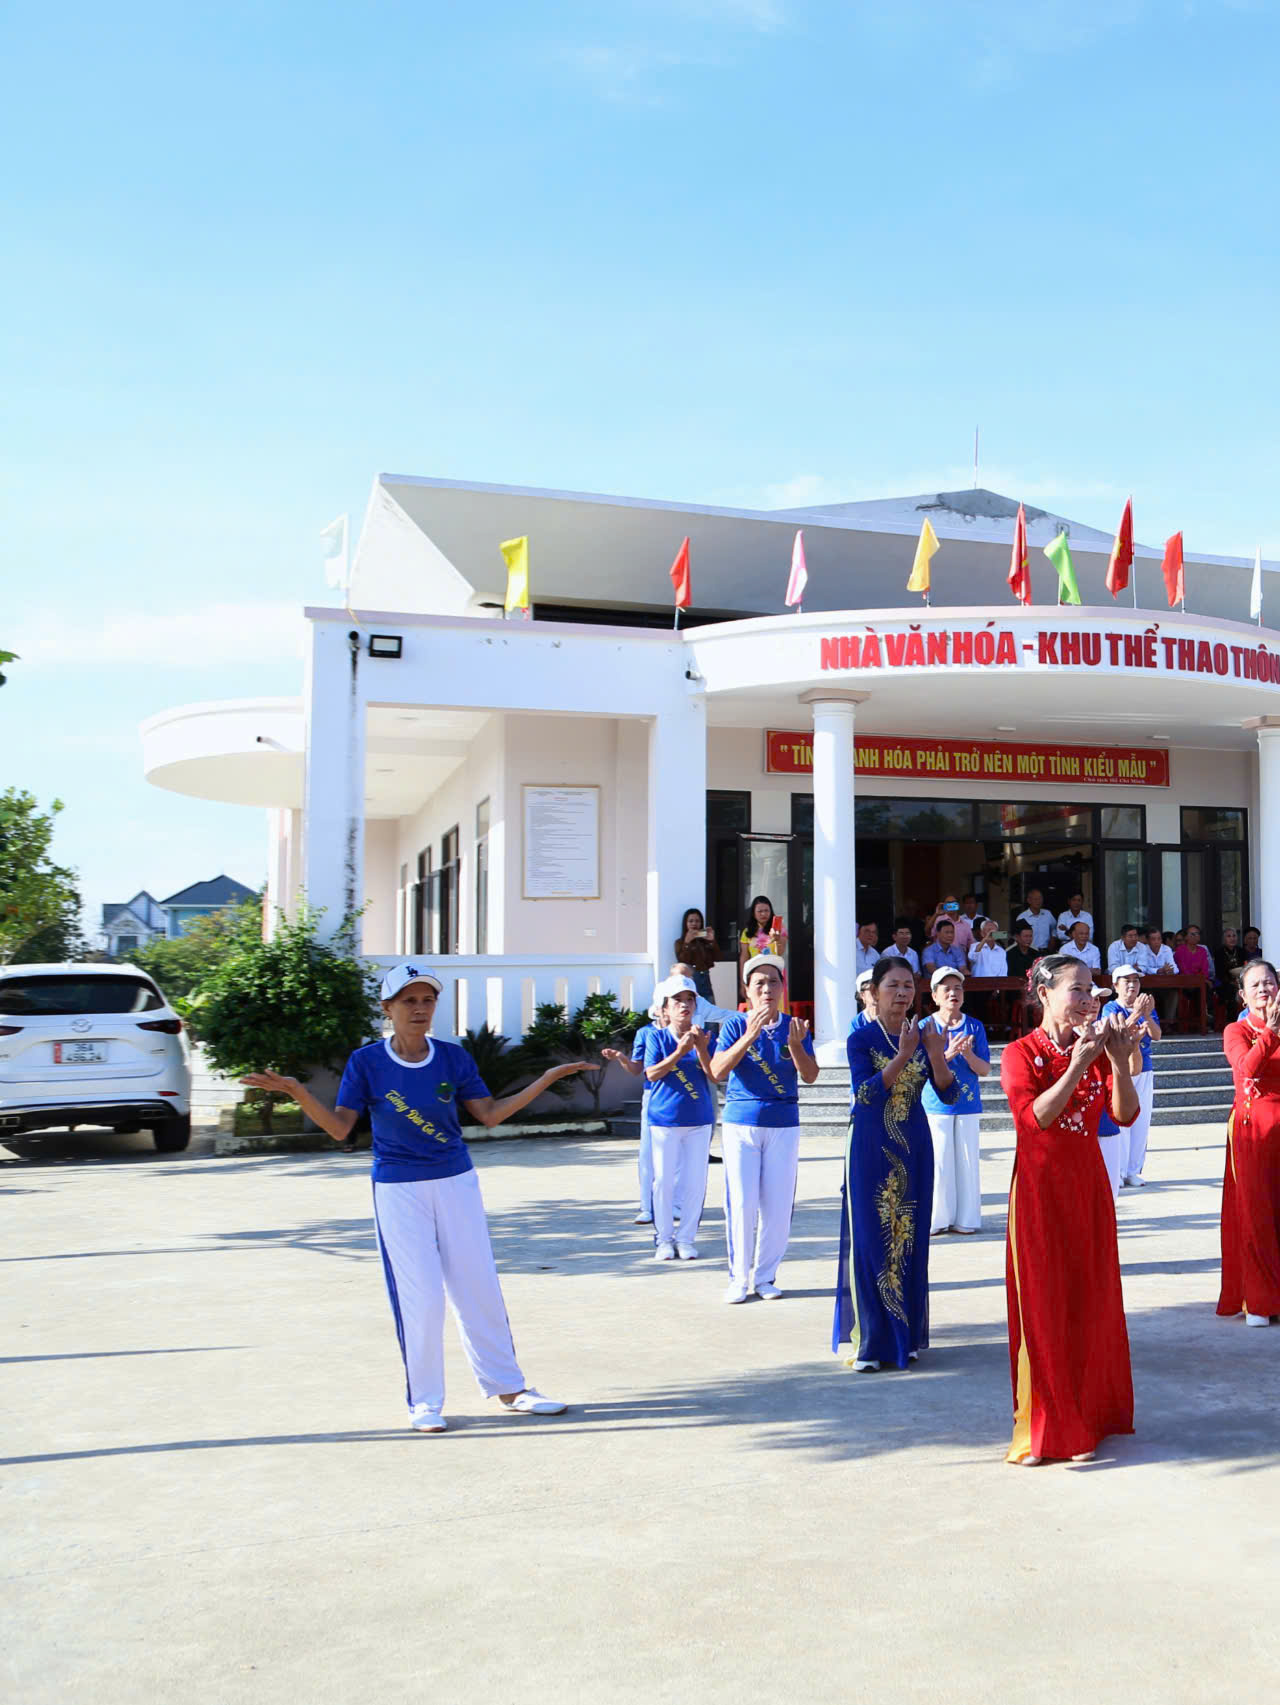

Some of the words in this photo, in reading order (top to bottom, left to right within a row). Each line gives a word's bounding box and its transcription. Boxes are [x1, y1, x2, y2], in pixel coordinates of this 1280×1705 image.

[820, 626, 882, 670] NHÀ
[885, 624, 948, 666] VĂN
[952, 621, 1017, 665] HÓA
[1038, 631, 1101, 666] KHU
[1105, 623, 1160, 668] THỂ
[1161, 637, 1229, 676] THAO
[1230, 643, 1280, 685] THÔN
[792, 740, 814, 766] TỈN
[854, 748, 879, 769] ANH
[883, 745, 913, 770] HÓA
[916, 745, 950, 771] PHẢI
[953, 747, 981, 773] TRỞ
[983, 750, 1013, 774] NÊN
[1017, 752, 1045, 778] MỘT
[1049, 751, 1080, 776] TỈNH
[1083, 752, 1114, 778] KIỂU
[1118, 753, 1147, 779] MẪU
